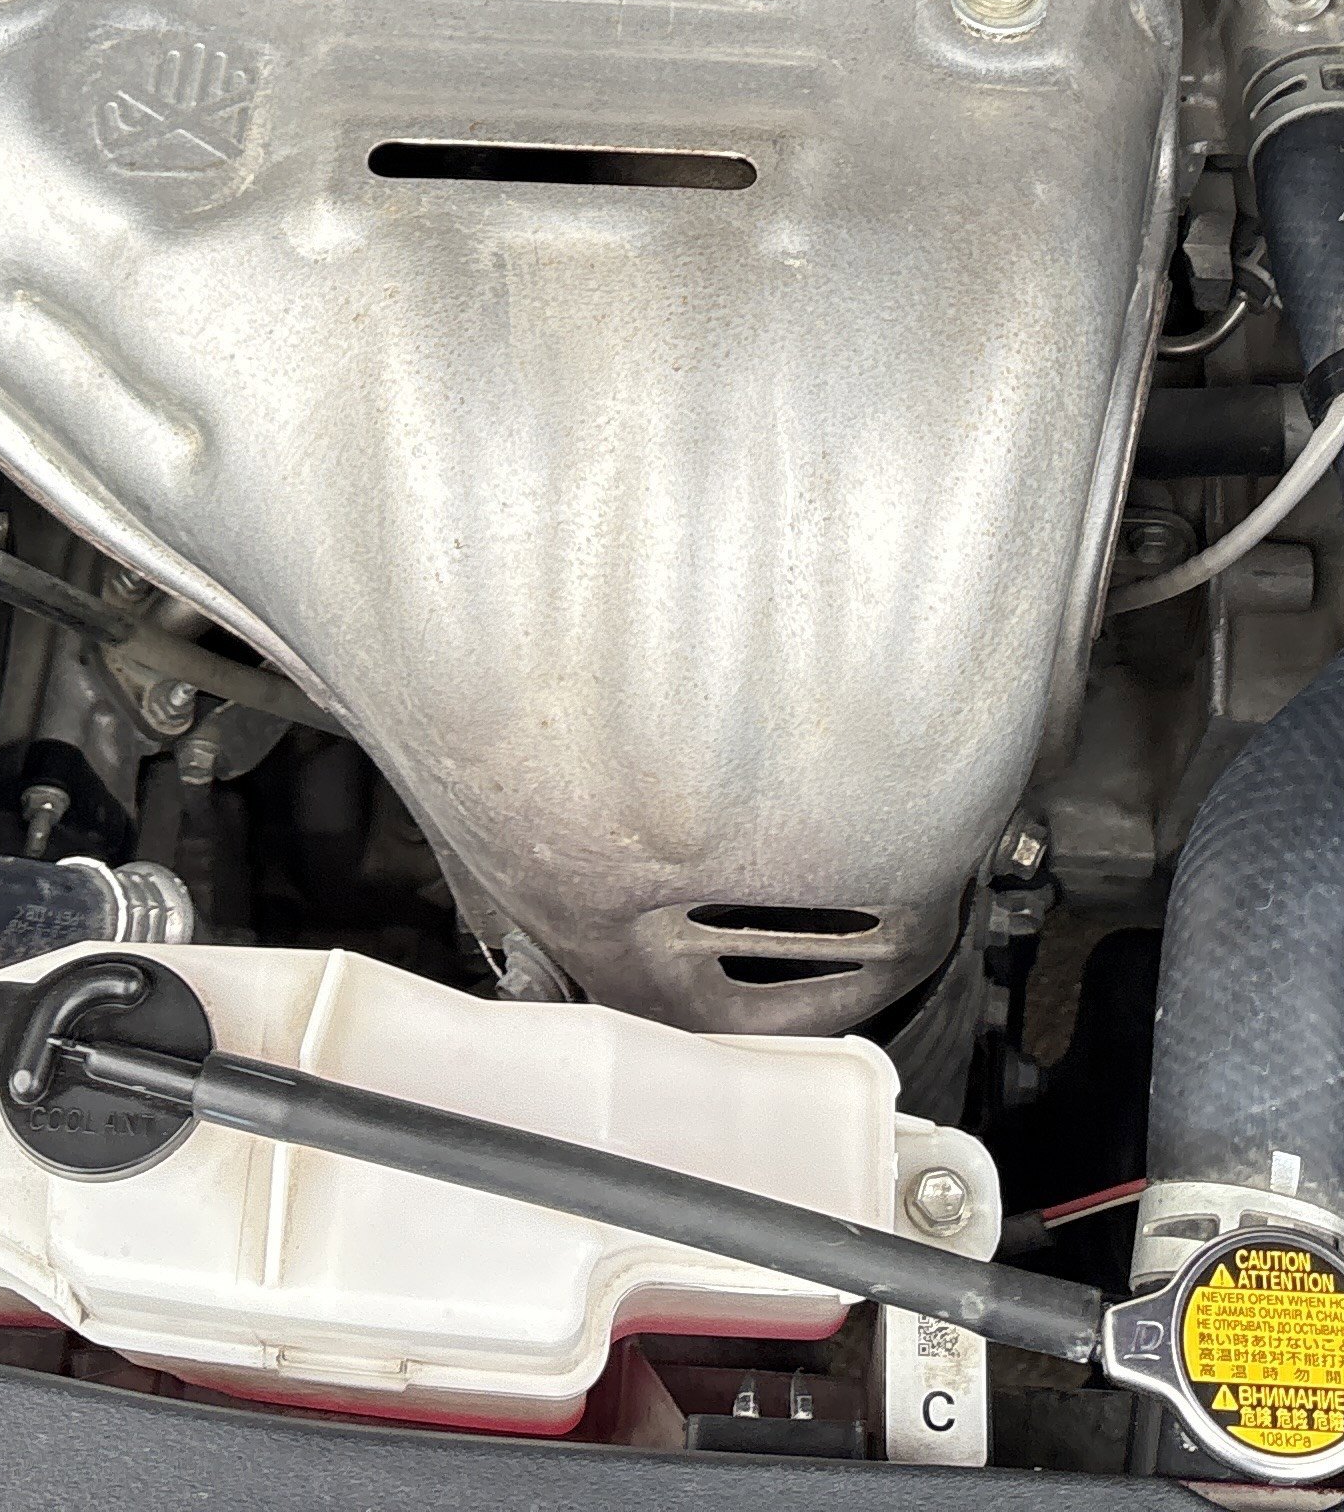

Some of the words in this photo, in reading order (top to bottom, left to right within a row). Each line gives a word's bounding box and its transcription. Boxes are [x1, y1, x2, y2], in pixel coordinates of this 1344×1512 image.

[30, 1106, 154, 1137] COOLANT
[1235, 1249, 1311, 1271] CAUTION
[1238, 1270, 1334, 1292] ATTENTION
[1201, 1291, 1244, 1304] NEVER
[1248, 1293, 1284, 1306] OPEN
[1287, 1295, 1325, 1308] WHEN
[1197, 1305, 1212, 1316] NE
[1215, 1306, 1255, 1318] JAMAIS
[1259, 1307, 1302, 1320] OUVRIR
[1197, 1319, 1211, 1330] НЕ
[1213, 1320, 1274, 1333] ОТКРЫВАТЬ
[1277, 1323, 1291, 1335] ДО
[922, 1390, 955, 1432] C
